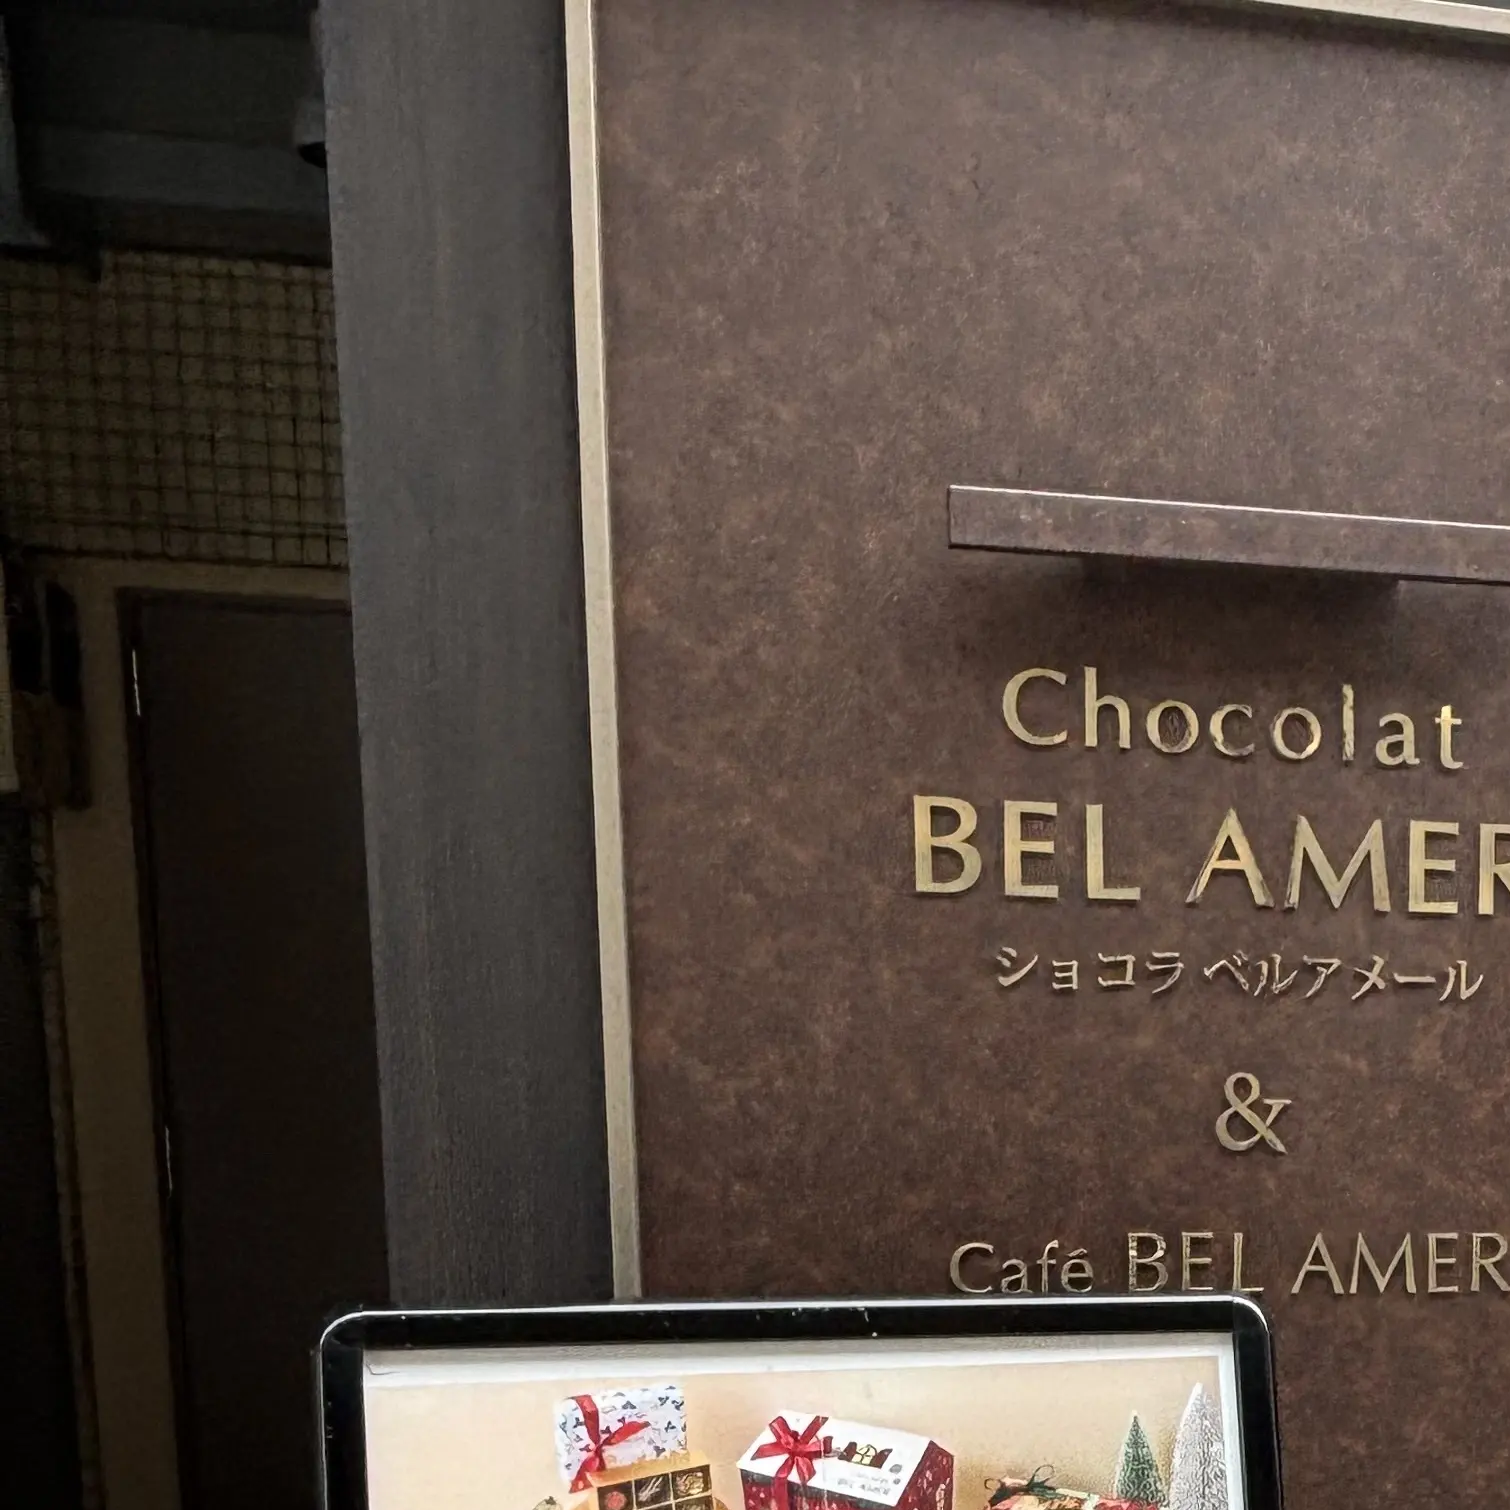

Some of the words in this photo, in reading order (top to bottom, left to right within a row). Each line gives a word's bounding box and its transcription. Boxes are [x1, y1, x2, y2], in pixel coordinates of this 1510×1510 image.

[1002, 666, 1465, 770] Chocolat
[912, 794, 1142, 903] BEL
[1214, 1071, 1292, 1155] &
[949, 1239, 1094, 1294] Café
[1127, 1232, 1264, 1293] BEL
